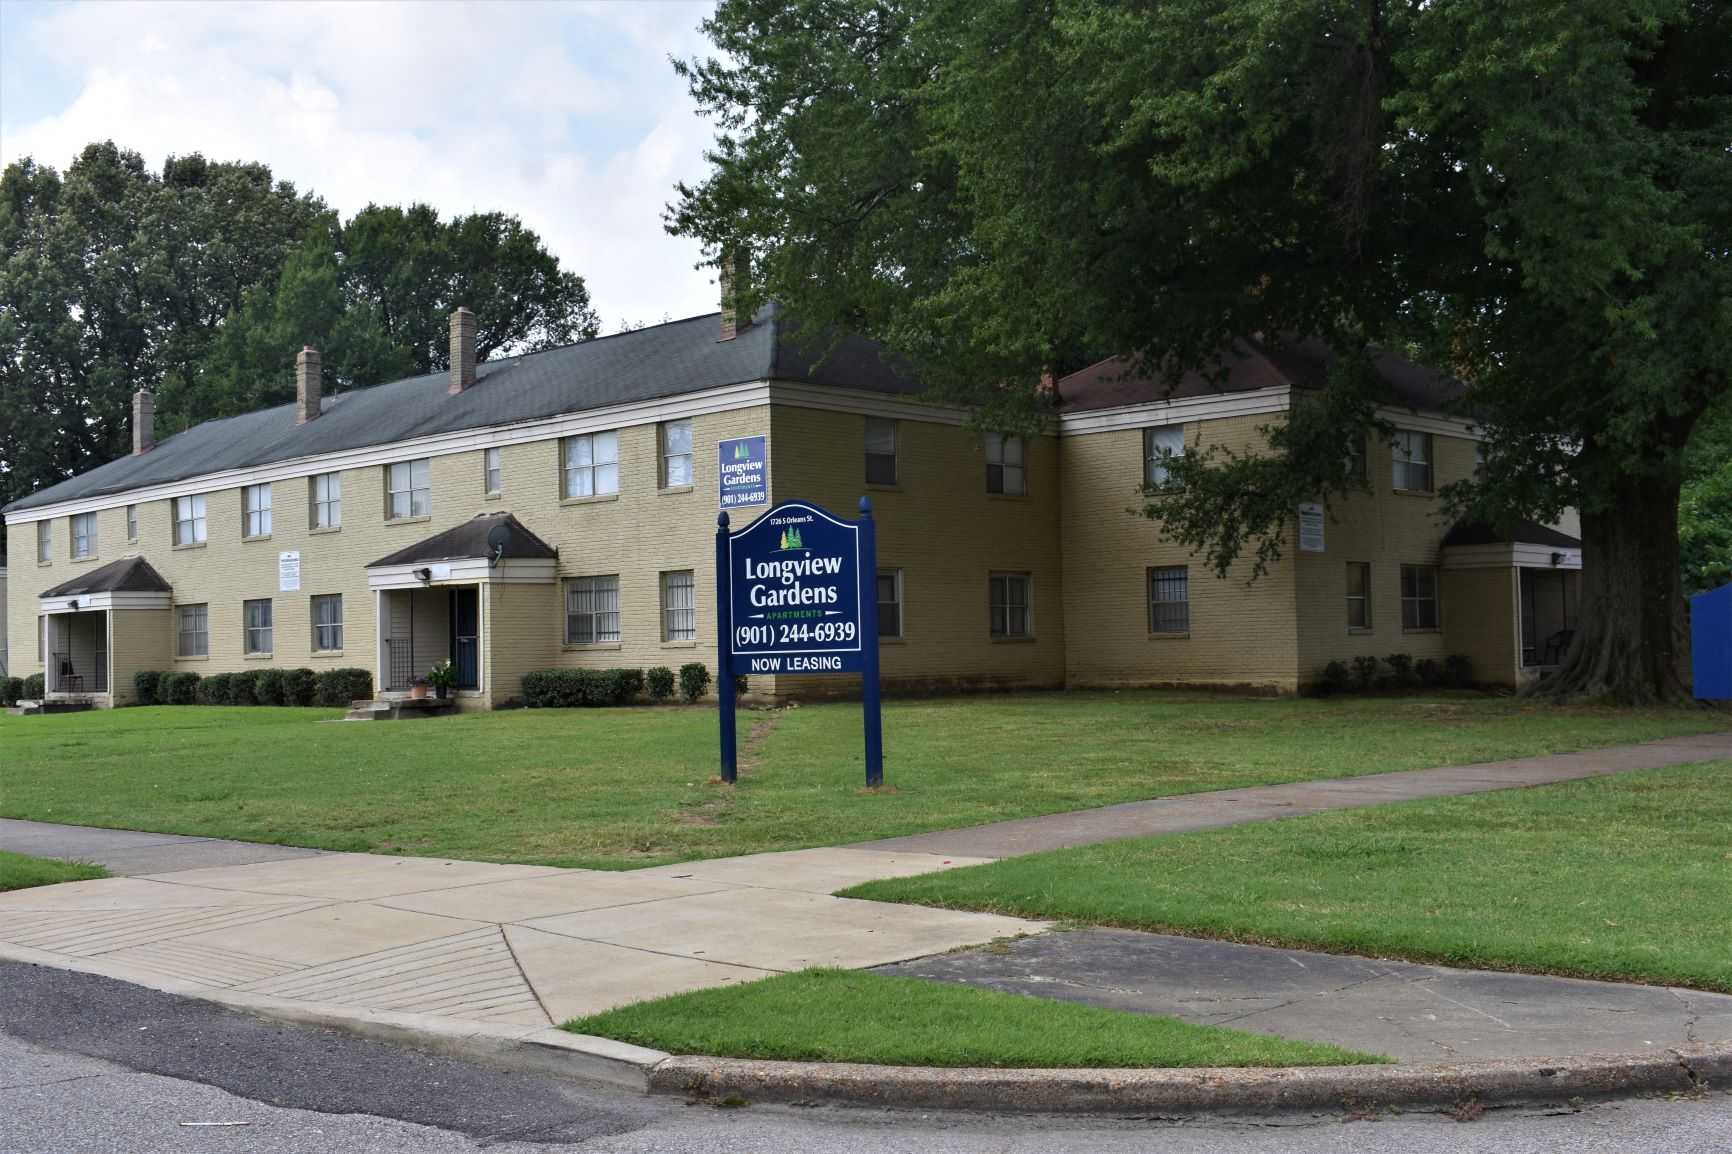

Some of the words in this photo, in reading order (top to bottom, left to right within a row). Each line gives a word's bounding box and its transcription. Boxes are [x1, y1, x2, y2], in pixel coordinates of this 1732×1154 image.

[721, 460, 763, 475] Longview
[723, 473, 761, 486] Gardens
[721, 494, 737, 506] (901)
[737, 492, 765, 503] 244-6939
[745, 552, 842, 585] Longview
[750, 581, 838, 607] Gardens
[766, 610, 823, 620] APARTMENTS
[736, 624, 775, 647] (901)
[779, 622, 856, 643] 244-6939
[751, 658, 781, 671] NOW
[787, 656, 842, 671] LEASING
